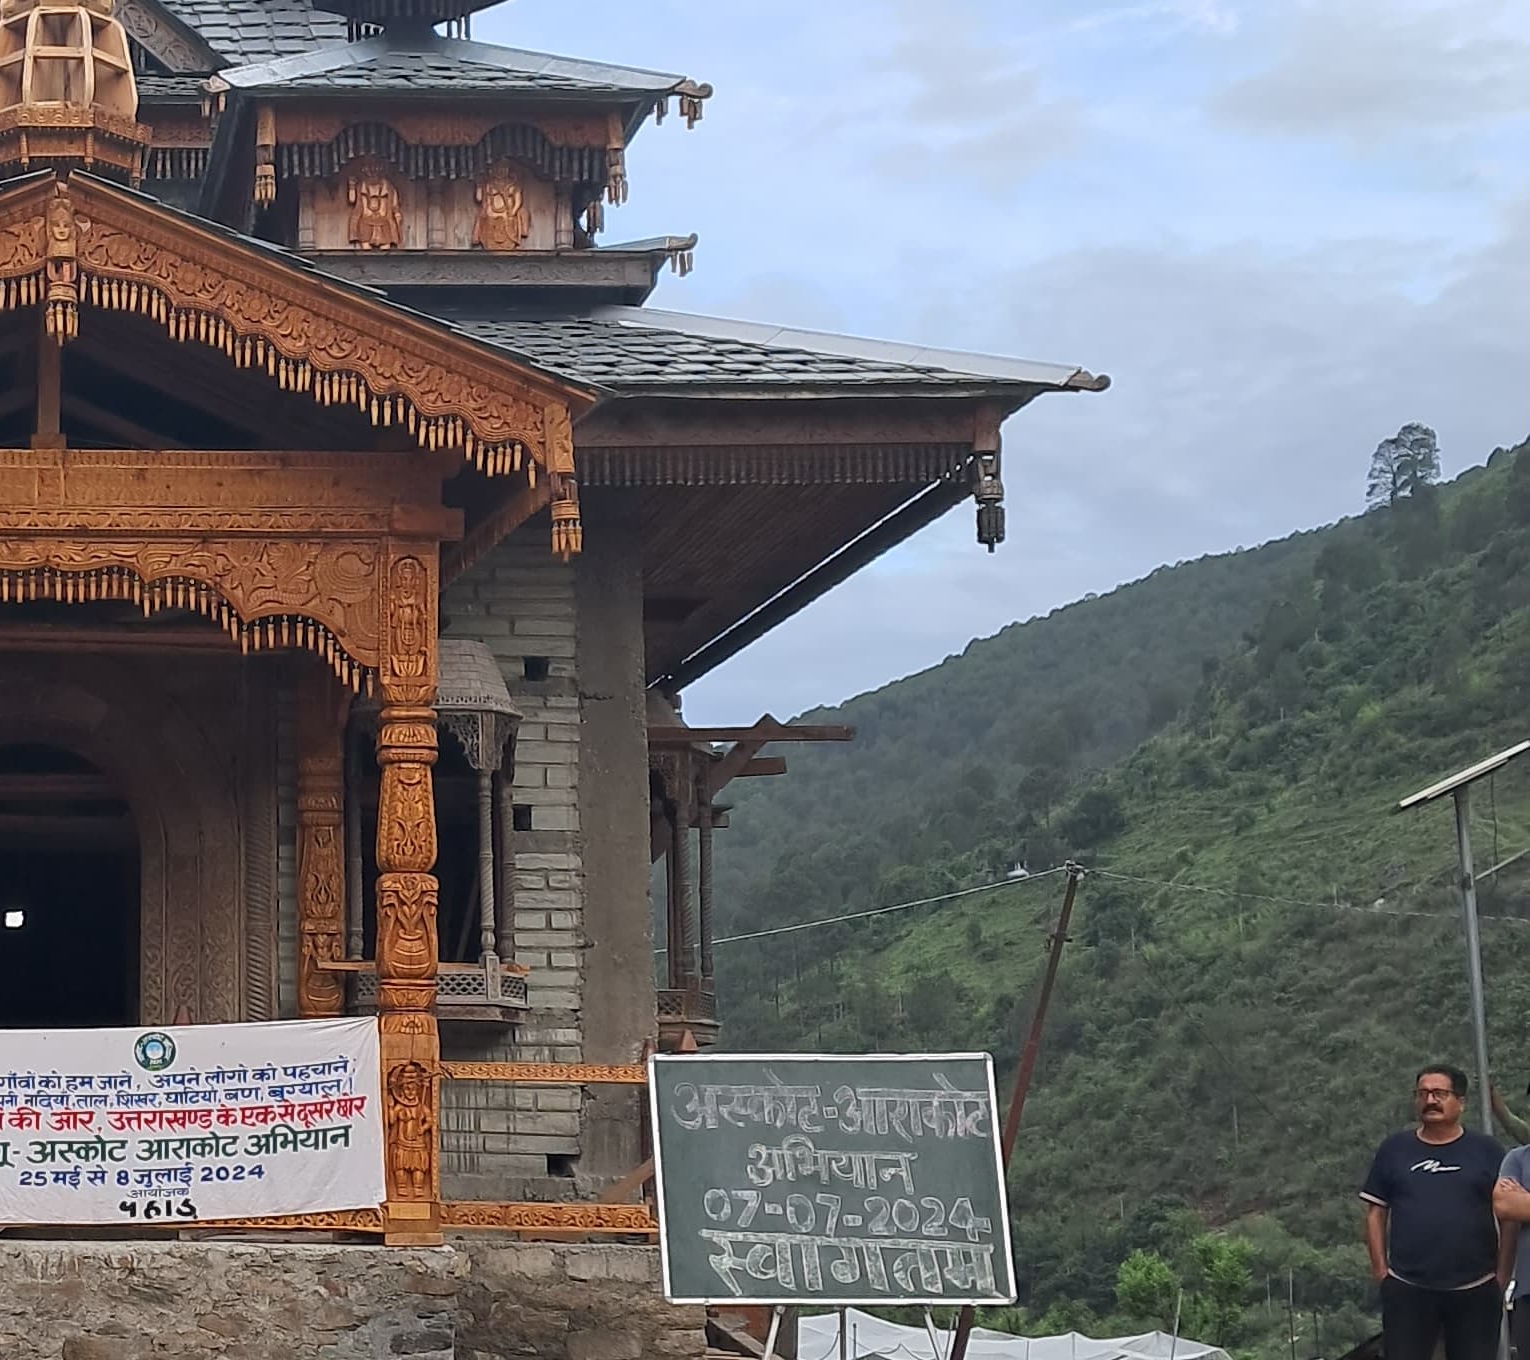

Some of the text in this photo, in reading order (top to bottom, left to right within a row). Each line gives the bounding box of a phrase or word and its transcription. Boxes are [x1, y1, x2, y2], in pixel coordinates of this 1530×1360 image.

[38, 1070, 62, 1088] को
[64, 1076, 94, 1093] हम
[148, 1067, 201, 1088] अपने
[251, 1062, 276, 1081] को
[8, 1107, 41, 1130] की
[216, 1104, 238, 1127] के
[240, 1105, 277, 1127] एक
[277, 1099, 298, 1122] से
[297, 1095, 335, 1128] दूसरे
[26, 1135, 128, 1163] अस्कोट
[135, 1131, 239, 1160] आराकोट
[243, 1124, 353, 1155] अभियान
[19, 1162, 265, 1189] 25 मई से 8 जुलाई 2024
[746, 1134, 919, 1195] अभियान
[126, 1186, 190, 1199] आयोजक
[703, 1188, 992, 1241] 07-07-2024
